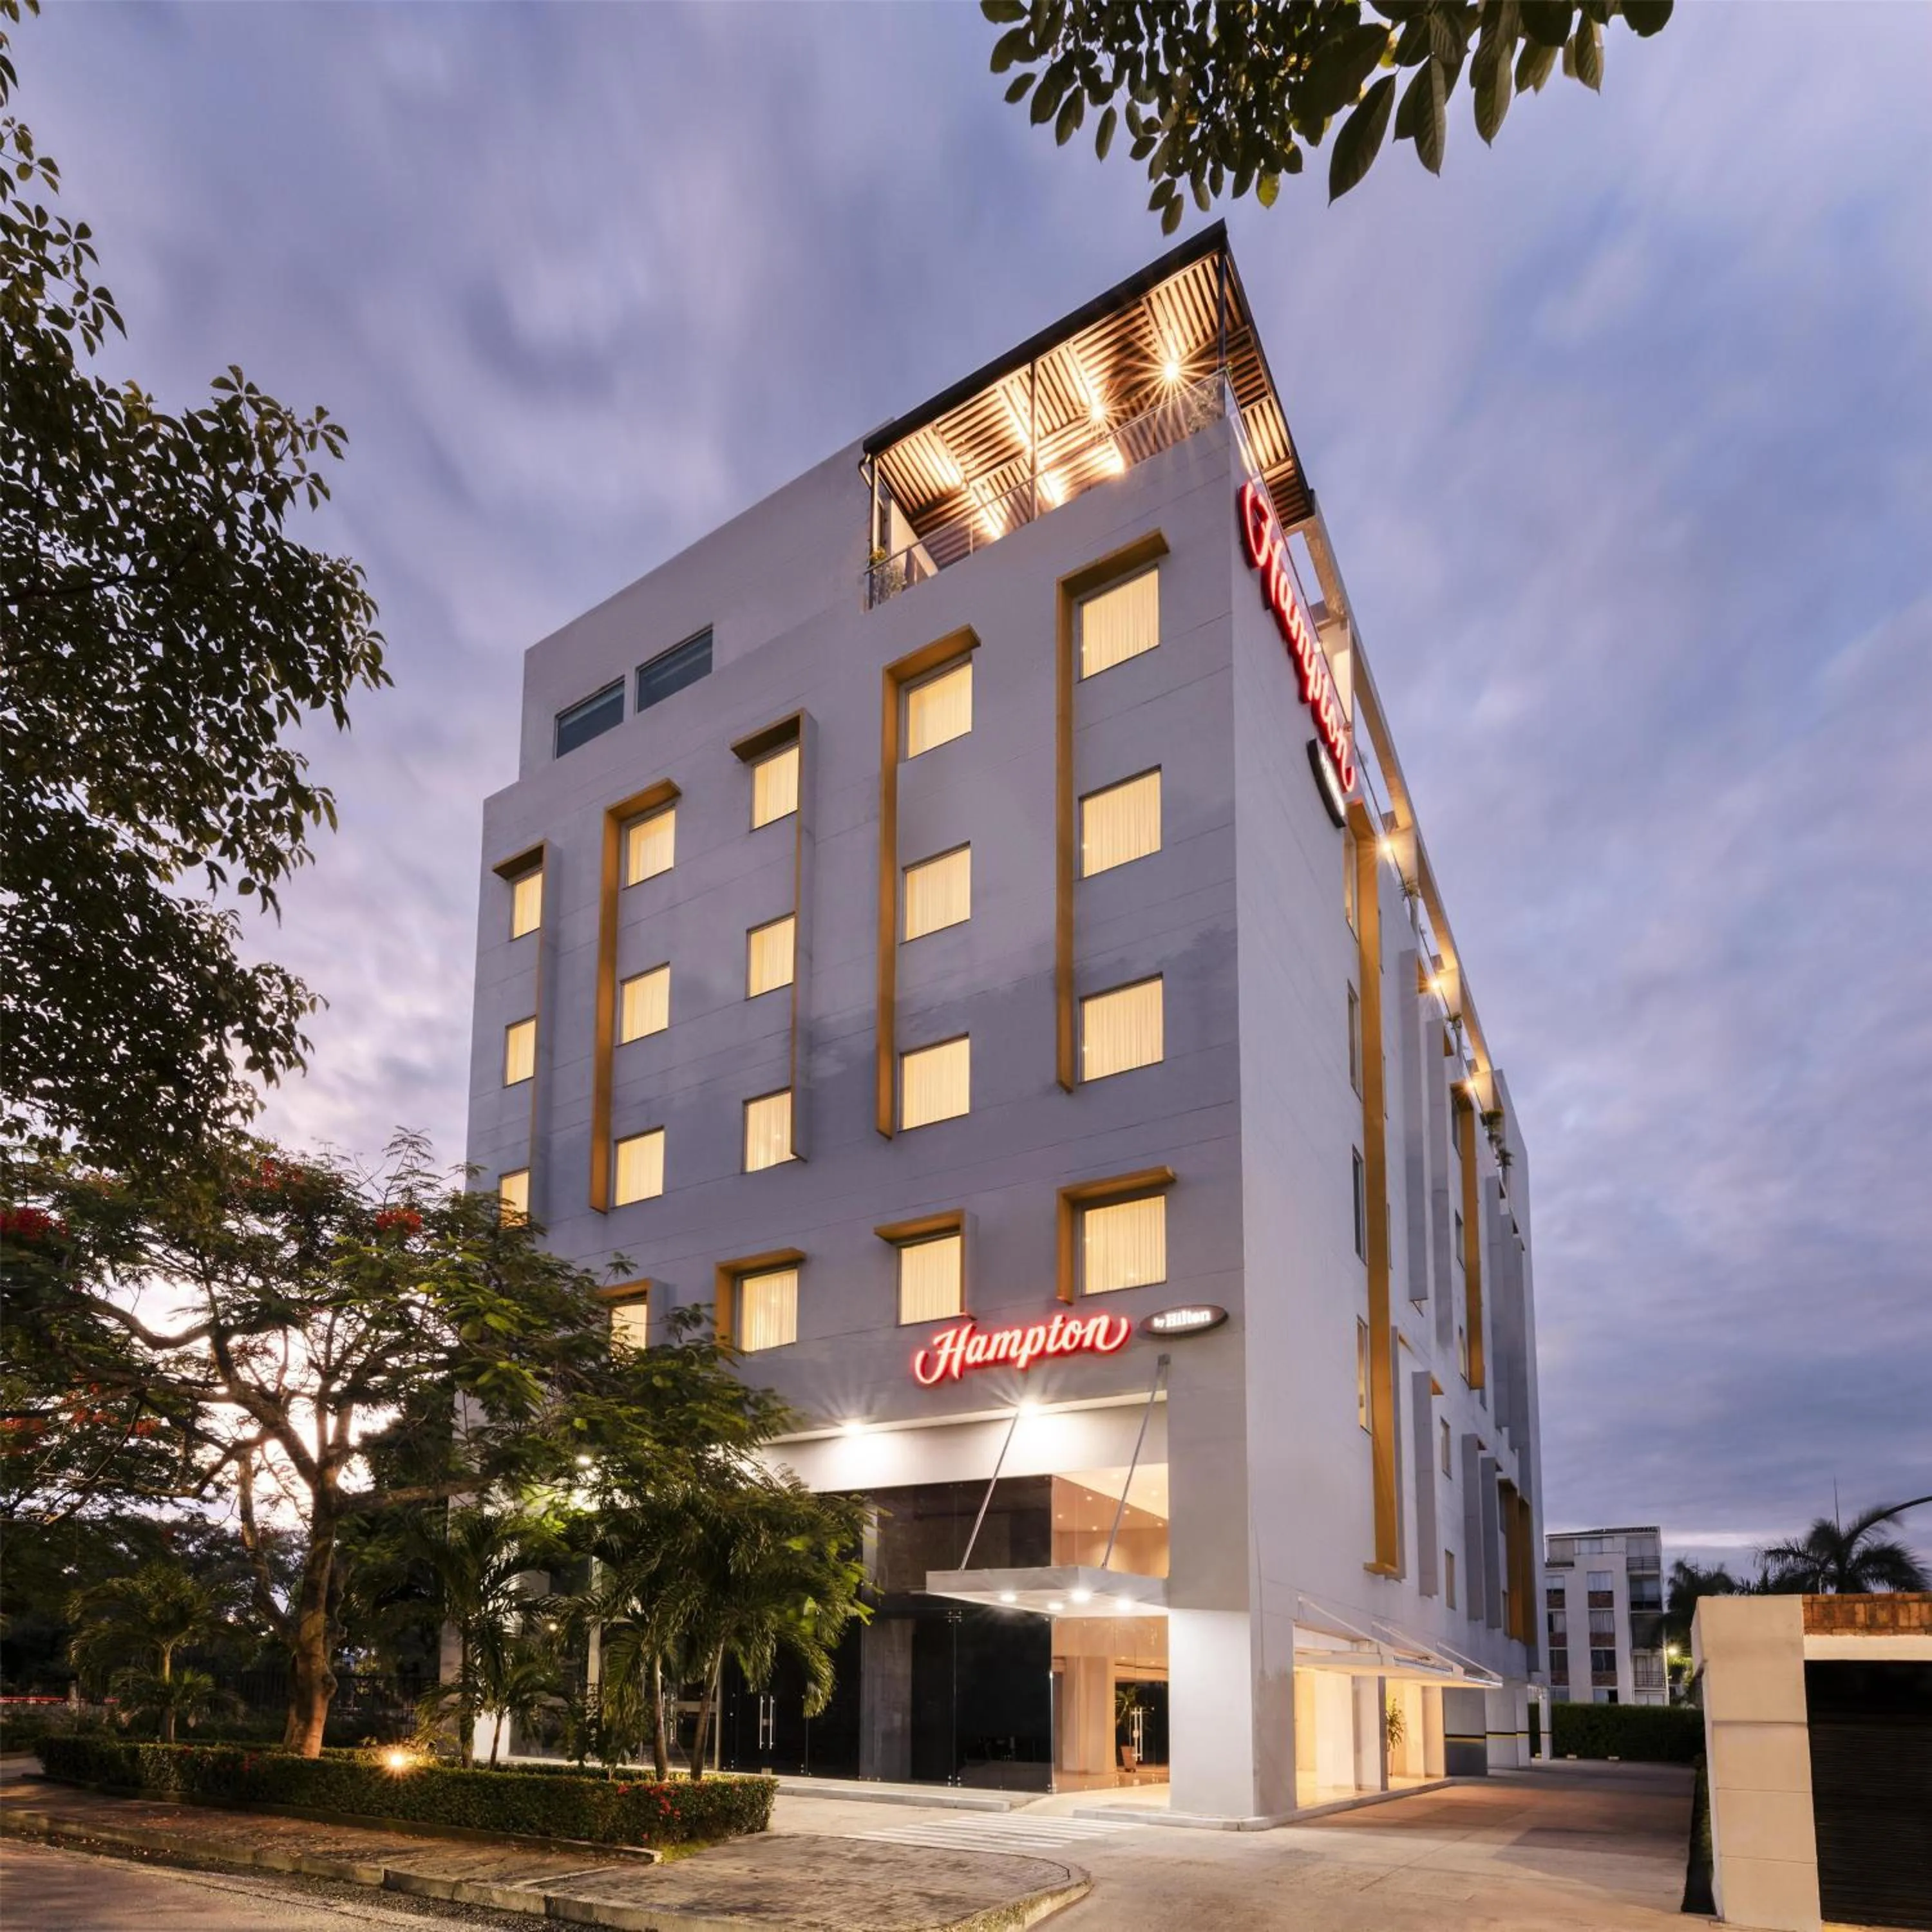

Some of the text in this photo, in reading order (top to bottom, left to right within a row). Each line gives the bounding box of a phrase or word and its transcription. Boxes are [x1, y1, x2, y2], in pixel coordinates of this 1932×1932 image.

[1238, 480, 1355, 793] Hampton
[914, 1314, 1130, 1385] Hampton
[1166, 1310, 1211, 1329] Hilton
